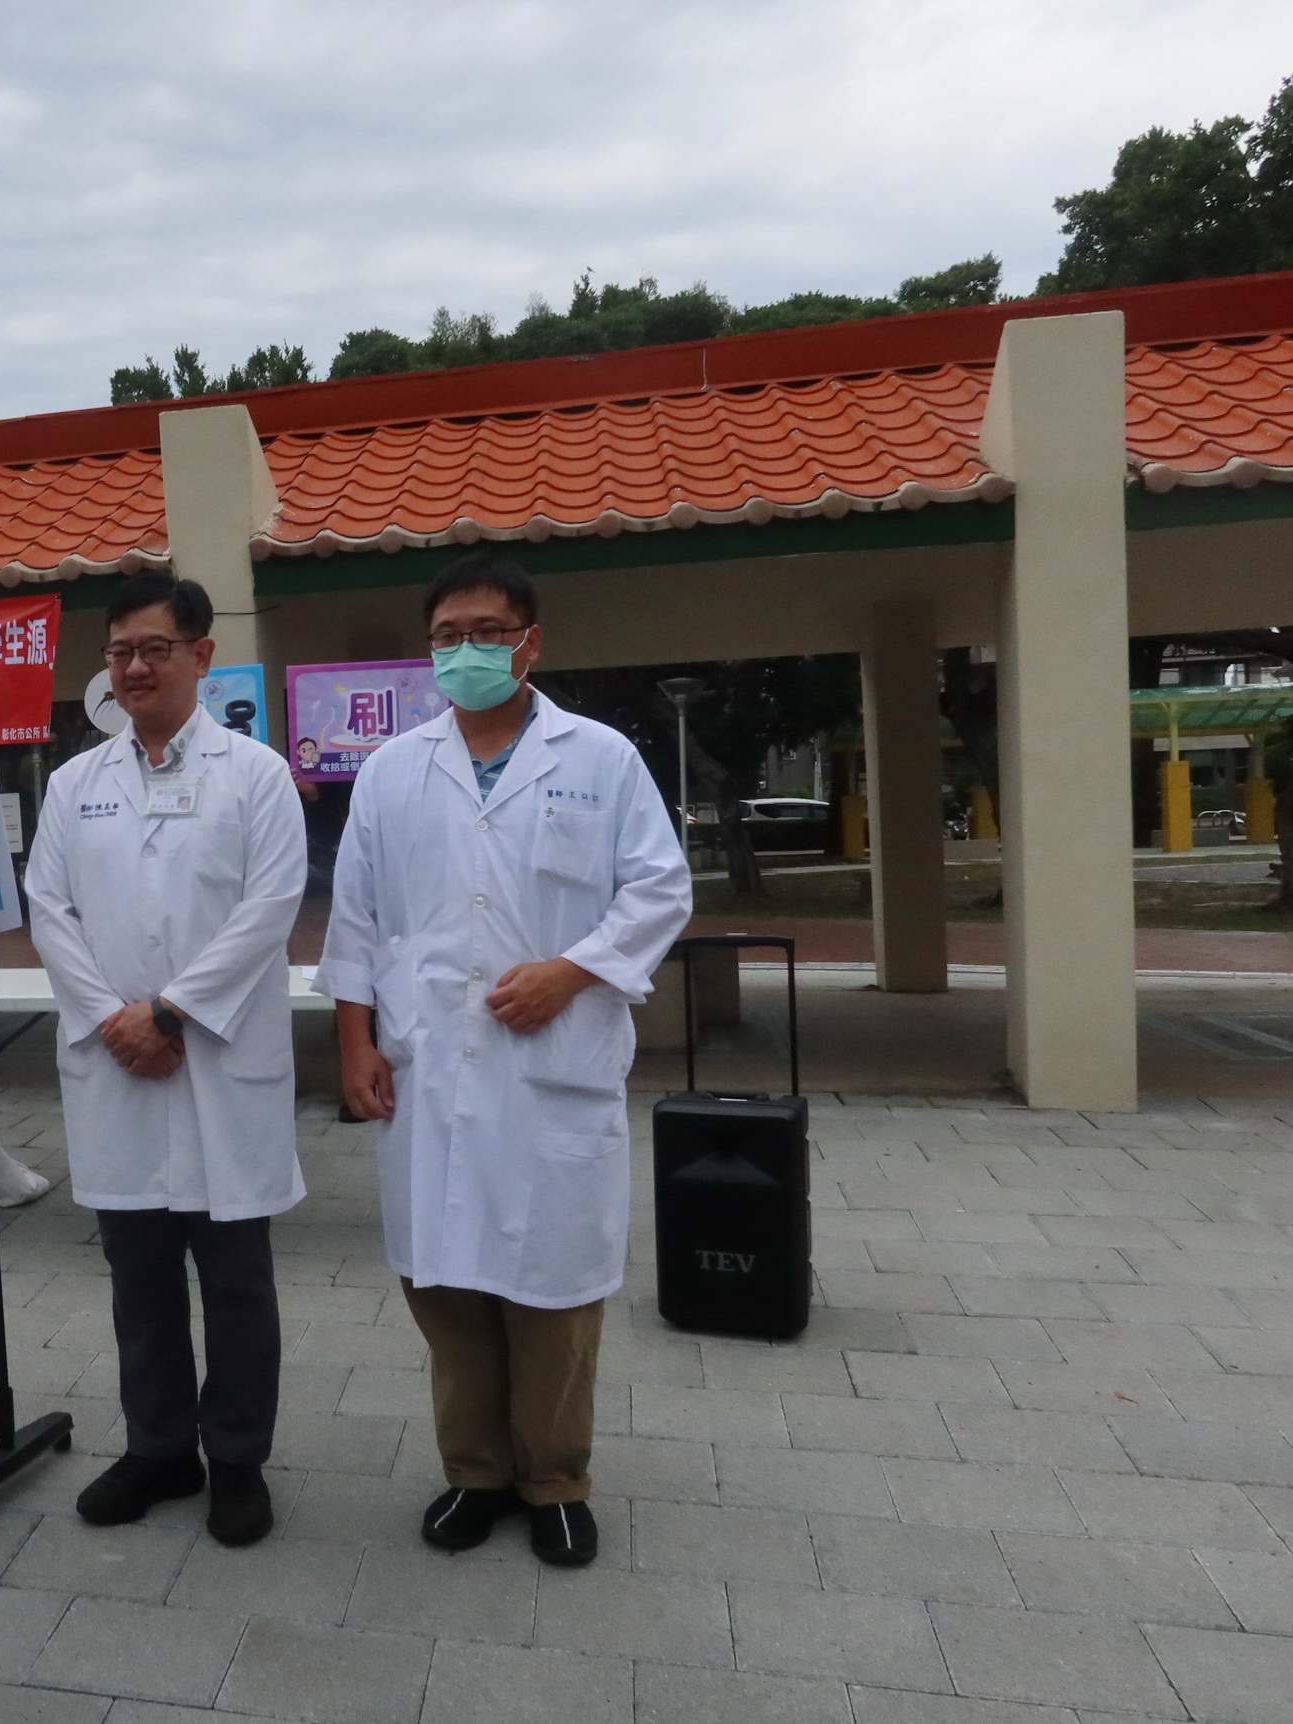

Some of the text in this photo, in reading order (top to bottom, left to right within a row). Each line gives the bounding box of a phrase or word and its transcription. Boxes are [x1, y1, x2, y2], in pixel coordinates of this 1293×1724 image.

[346, 687, 398, 740] 刷
[1, 727, 40, 742] 彰化市公所
[340, 751, 372, 762] 去除斑
[320, 762, 363, 773] 收拾或倒
[695, 1250, 756, 1273] TEV
